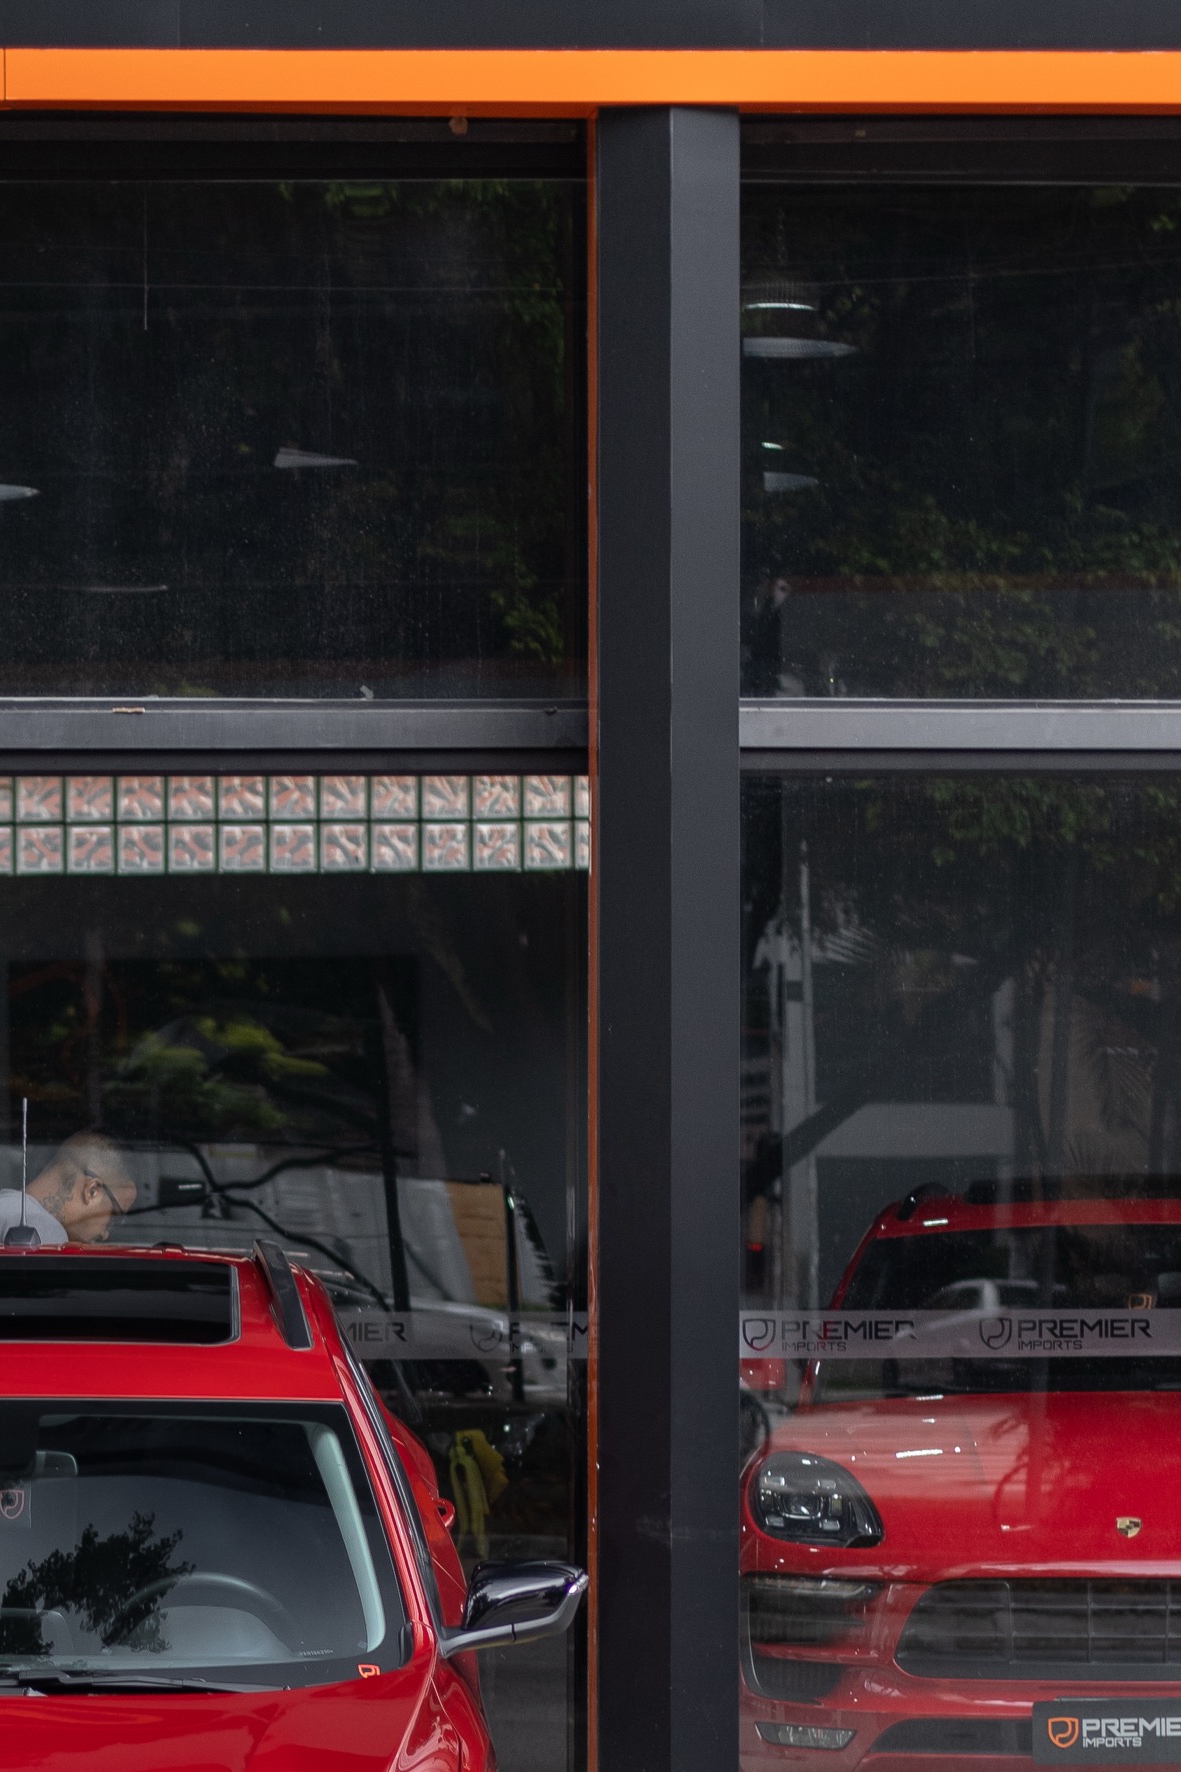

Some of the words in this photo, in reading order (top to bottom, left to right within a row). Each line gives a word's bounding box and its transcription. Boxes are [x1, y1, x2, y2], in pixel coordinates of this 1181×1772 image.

[782, 1320, 917, 1340] PREMIER
[1018, 1318, 1153, 1338] PREMIER
[782, 1341, 847, 1351] IMPORTS
[1018, 1339, 1083, 1350] IMPORTS
[1083, 1737, 1142, 1748] IMPORTS
